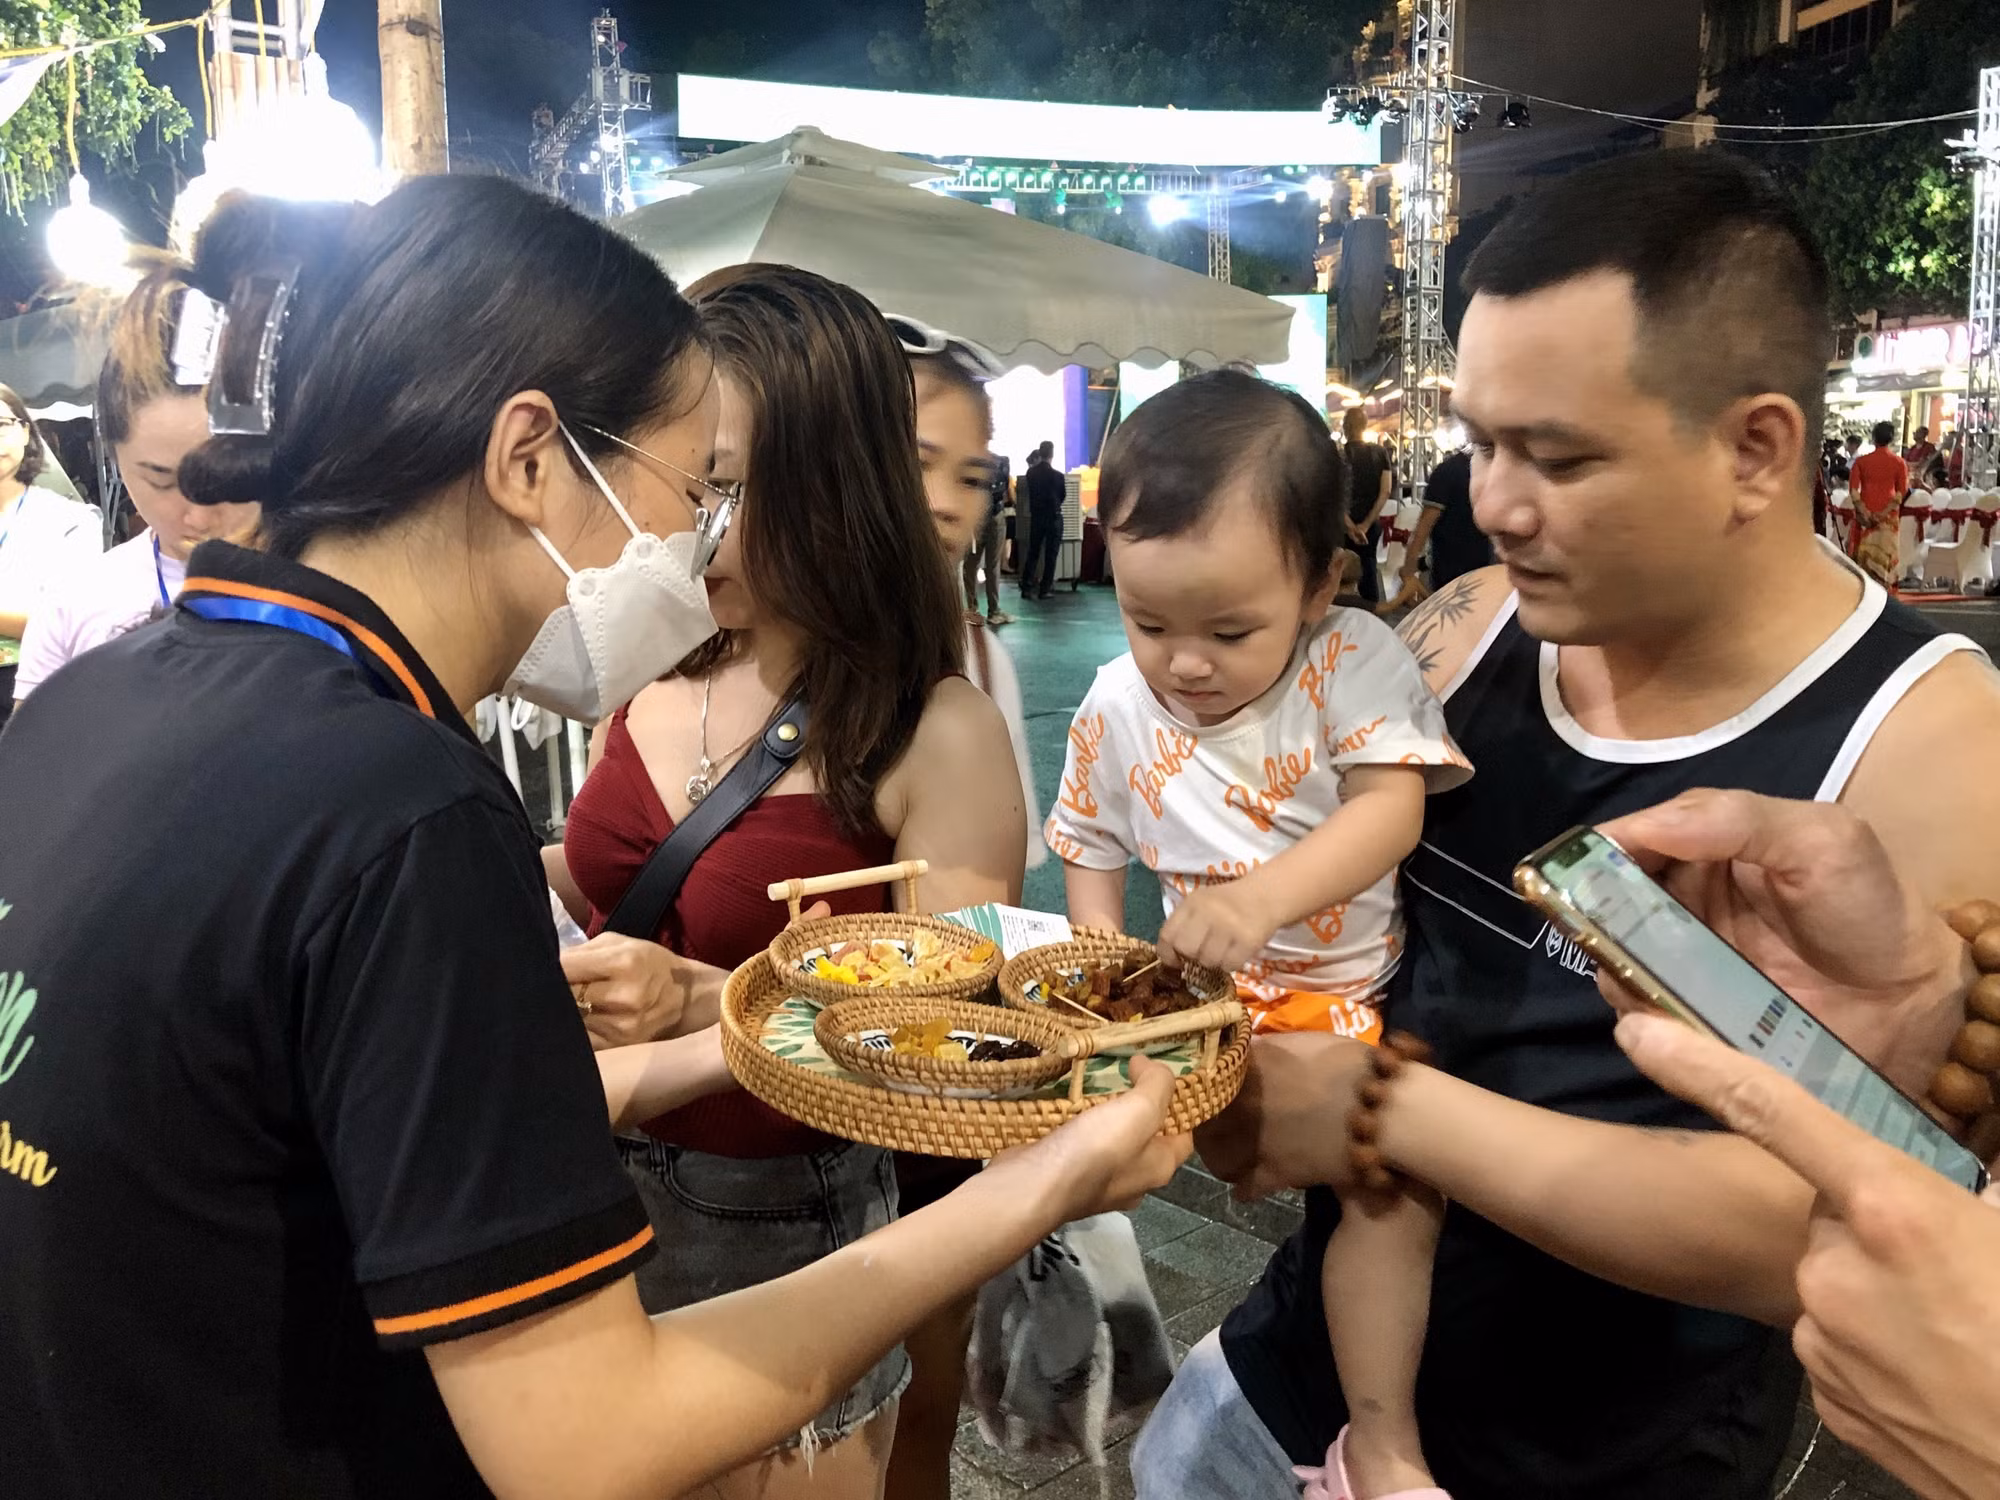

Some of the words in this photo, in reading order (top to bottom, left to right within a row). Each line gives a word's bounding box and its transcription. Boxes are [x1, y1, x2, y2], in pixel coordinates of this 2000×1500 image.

[1060, 713, 1105, 819] Barbie
[1129, 727, 1198, 821] Barbie
[1224, 747, 1311, 832] Barbie
